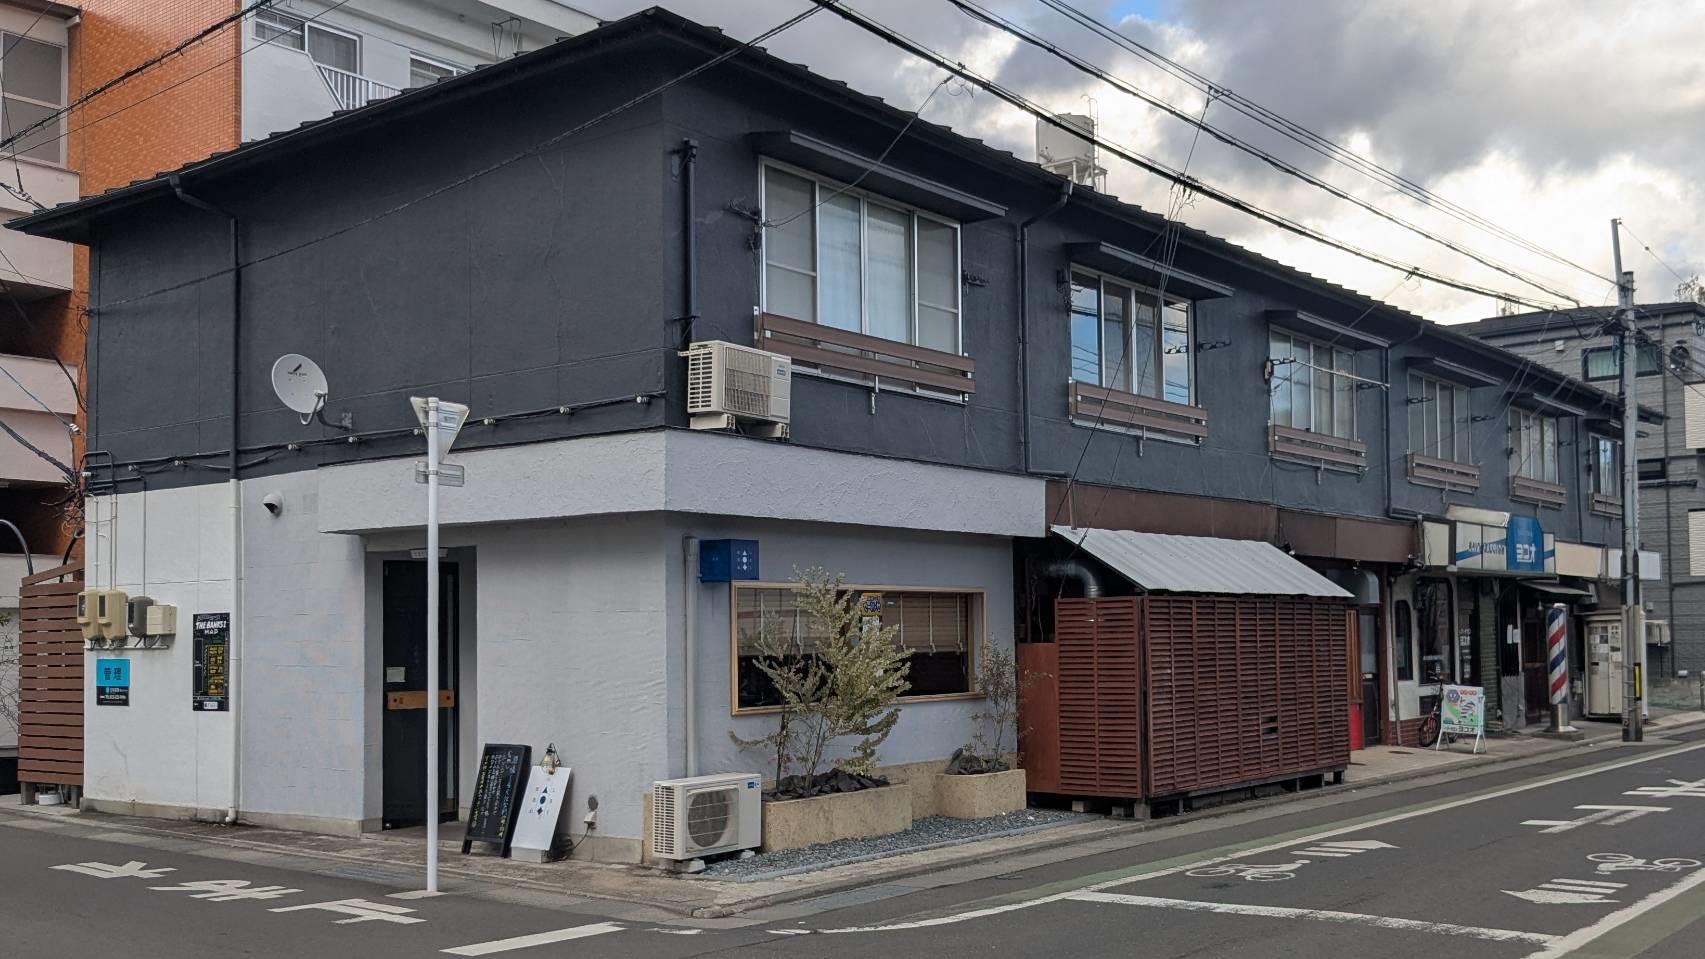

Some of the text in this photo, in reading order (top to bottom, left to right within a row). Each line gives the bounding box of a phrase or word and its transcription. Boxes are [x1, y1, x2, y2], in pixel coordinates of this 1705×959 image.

[1516, 544, 1536, 565] ヨコオ
[196, 621, 206, 630] THE
[50, 861, 427, 925] 止まれ
